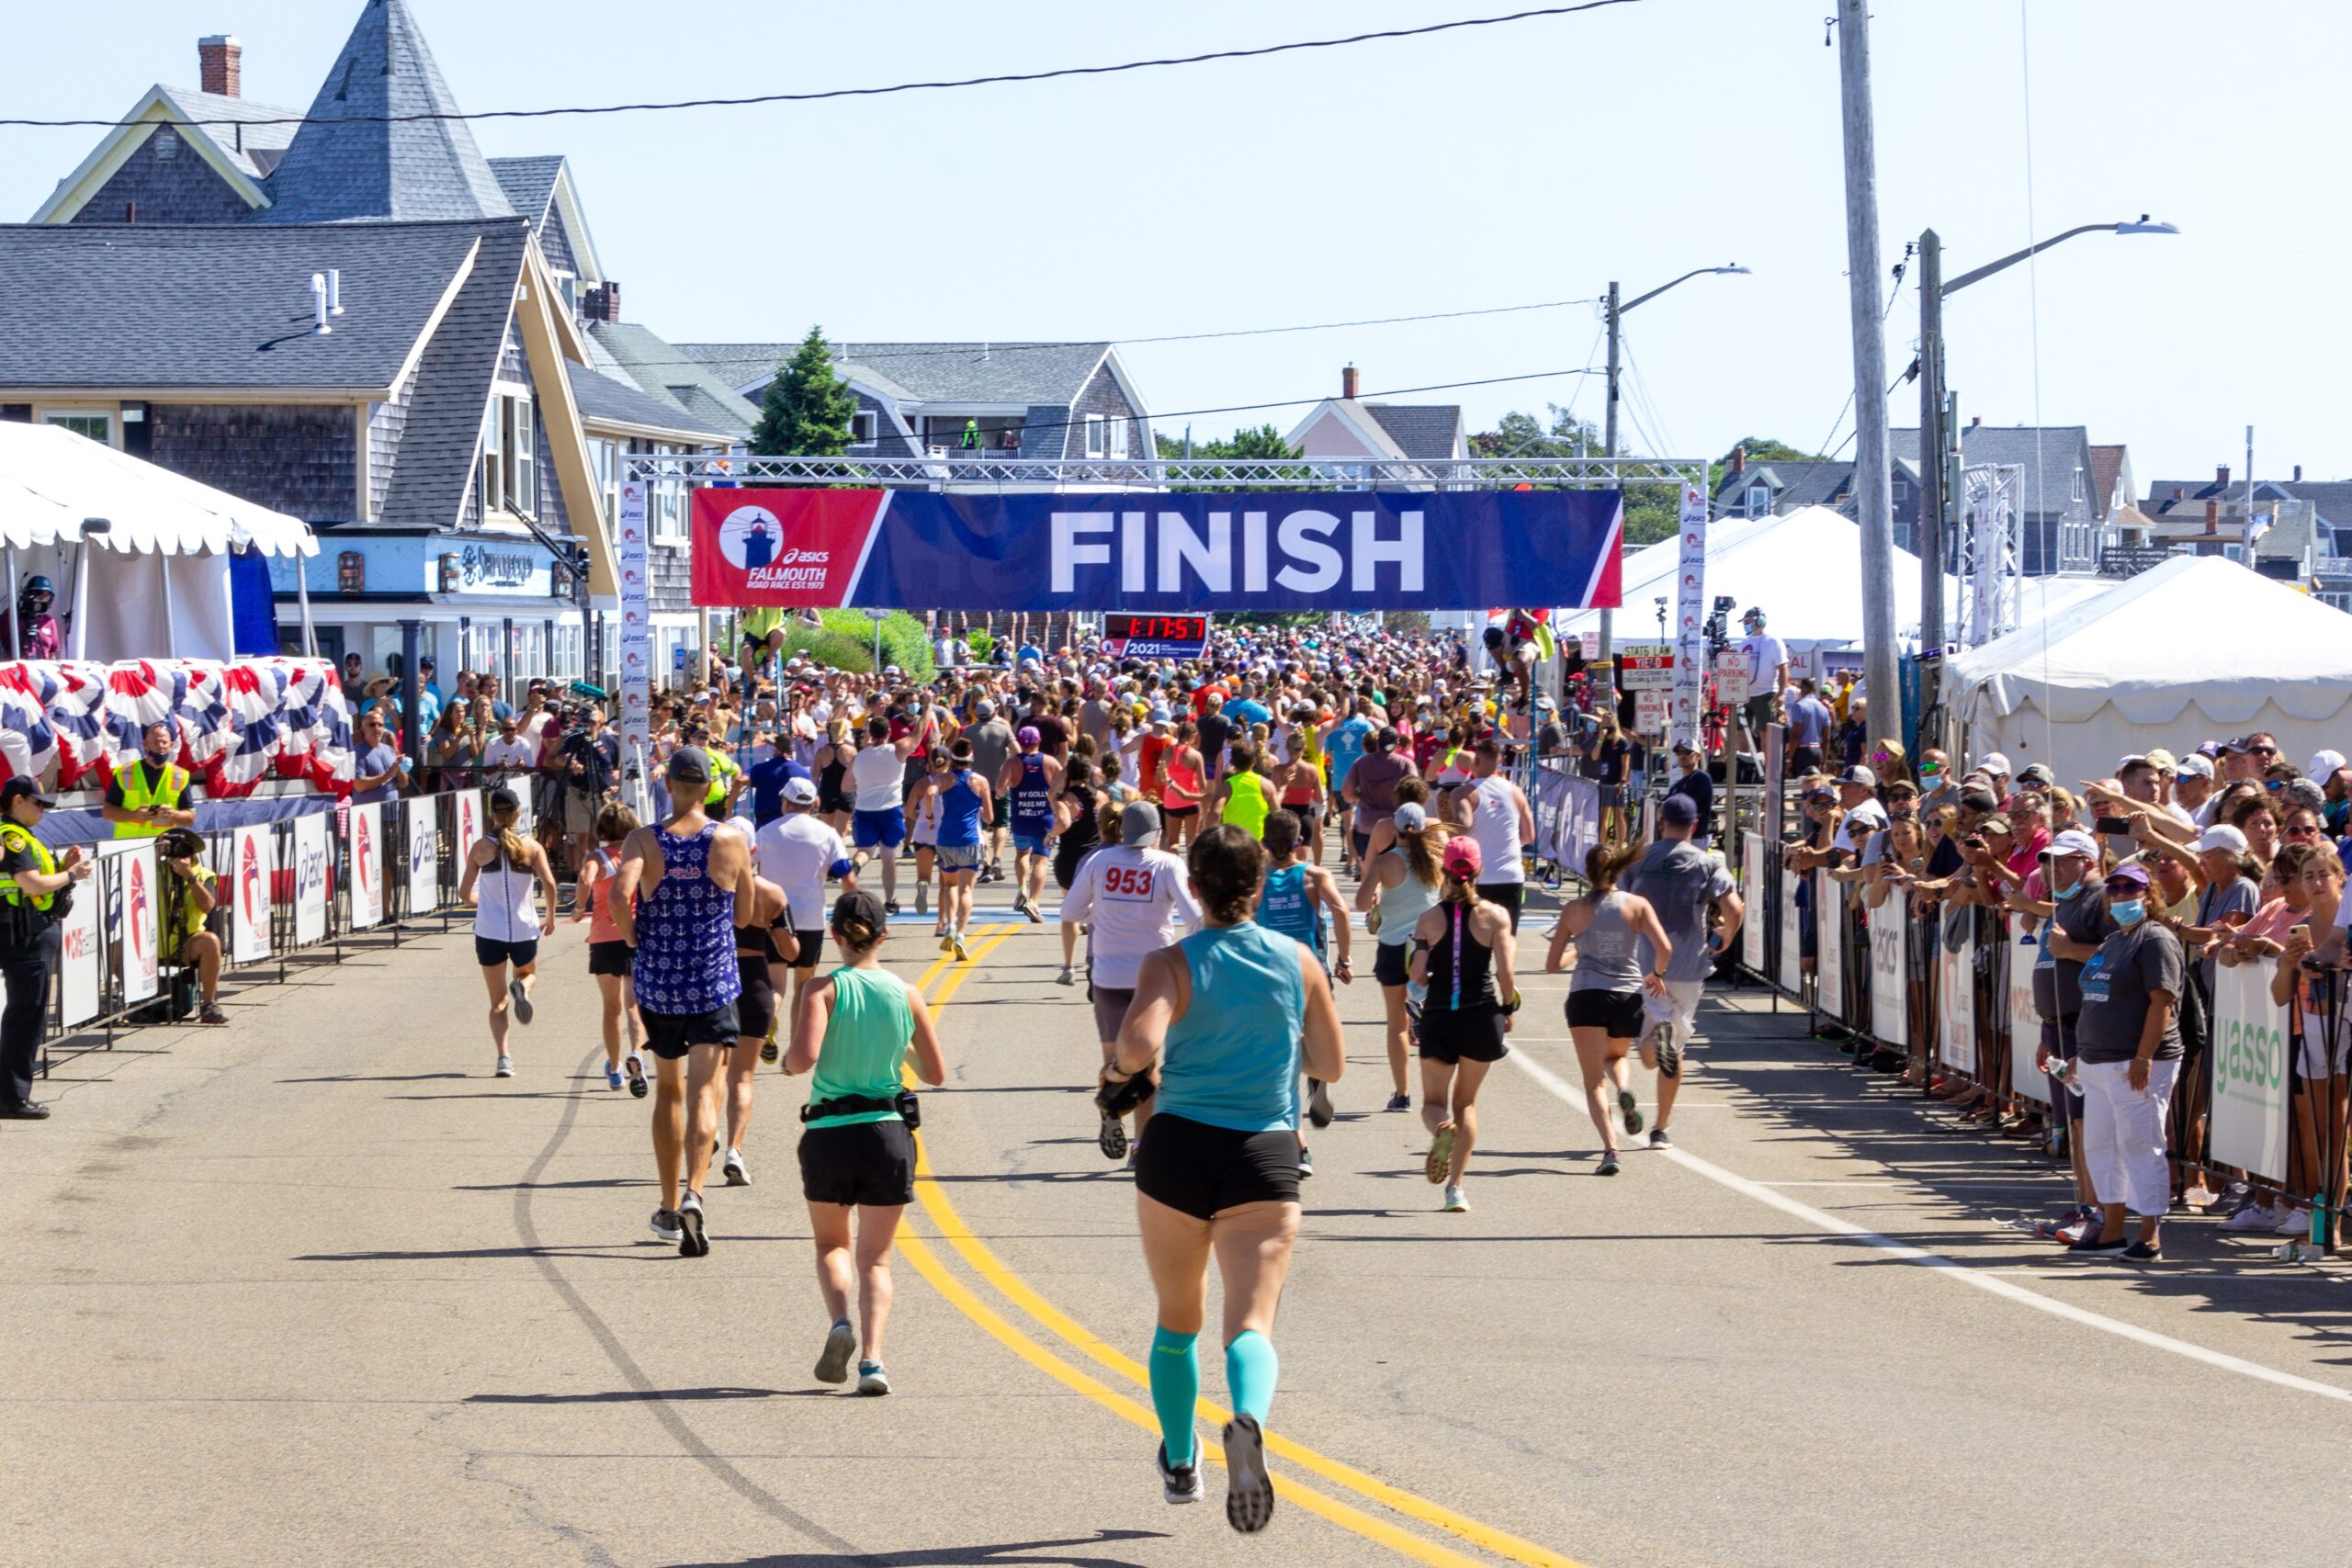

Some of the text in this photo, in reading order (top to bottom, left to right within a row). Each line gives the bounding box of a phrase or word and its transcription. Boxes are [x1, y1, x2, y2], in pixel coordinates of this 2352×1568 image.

[797, 551, 829, 562] asics
[1051, 510, 1424, 593] FINISH
[748, 567, 827, 581] FALMOUTH
[746, 581, 769, 589] ROAD
[770, 581, 790, 589] RACE
[1129, 617, 1204, 639] 1:17:57
[1128, 643, 1160, 655] 2021
[1653, 645, 1670, 655] LAW
[1635, 658, 1662, 669] YIELD
[1727, 657, 1740, 667] NO
[1719, 669, 1747, 678] PARKING
[1105, 866, 1152, 896] 953
[2217, 1016, 2282, 1094] yasso
